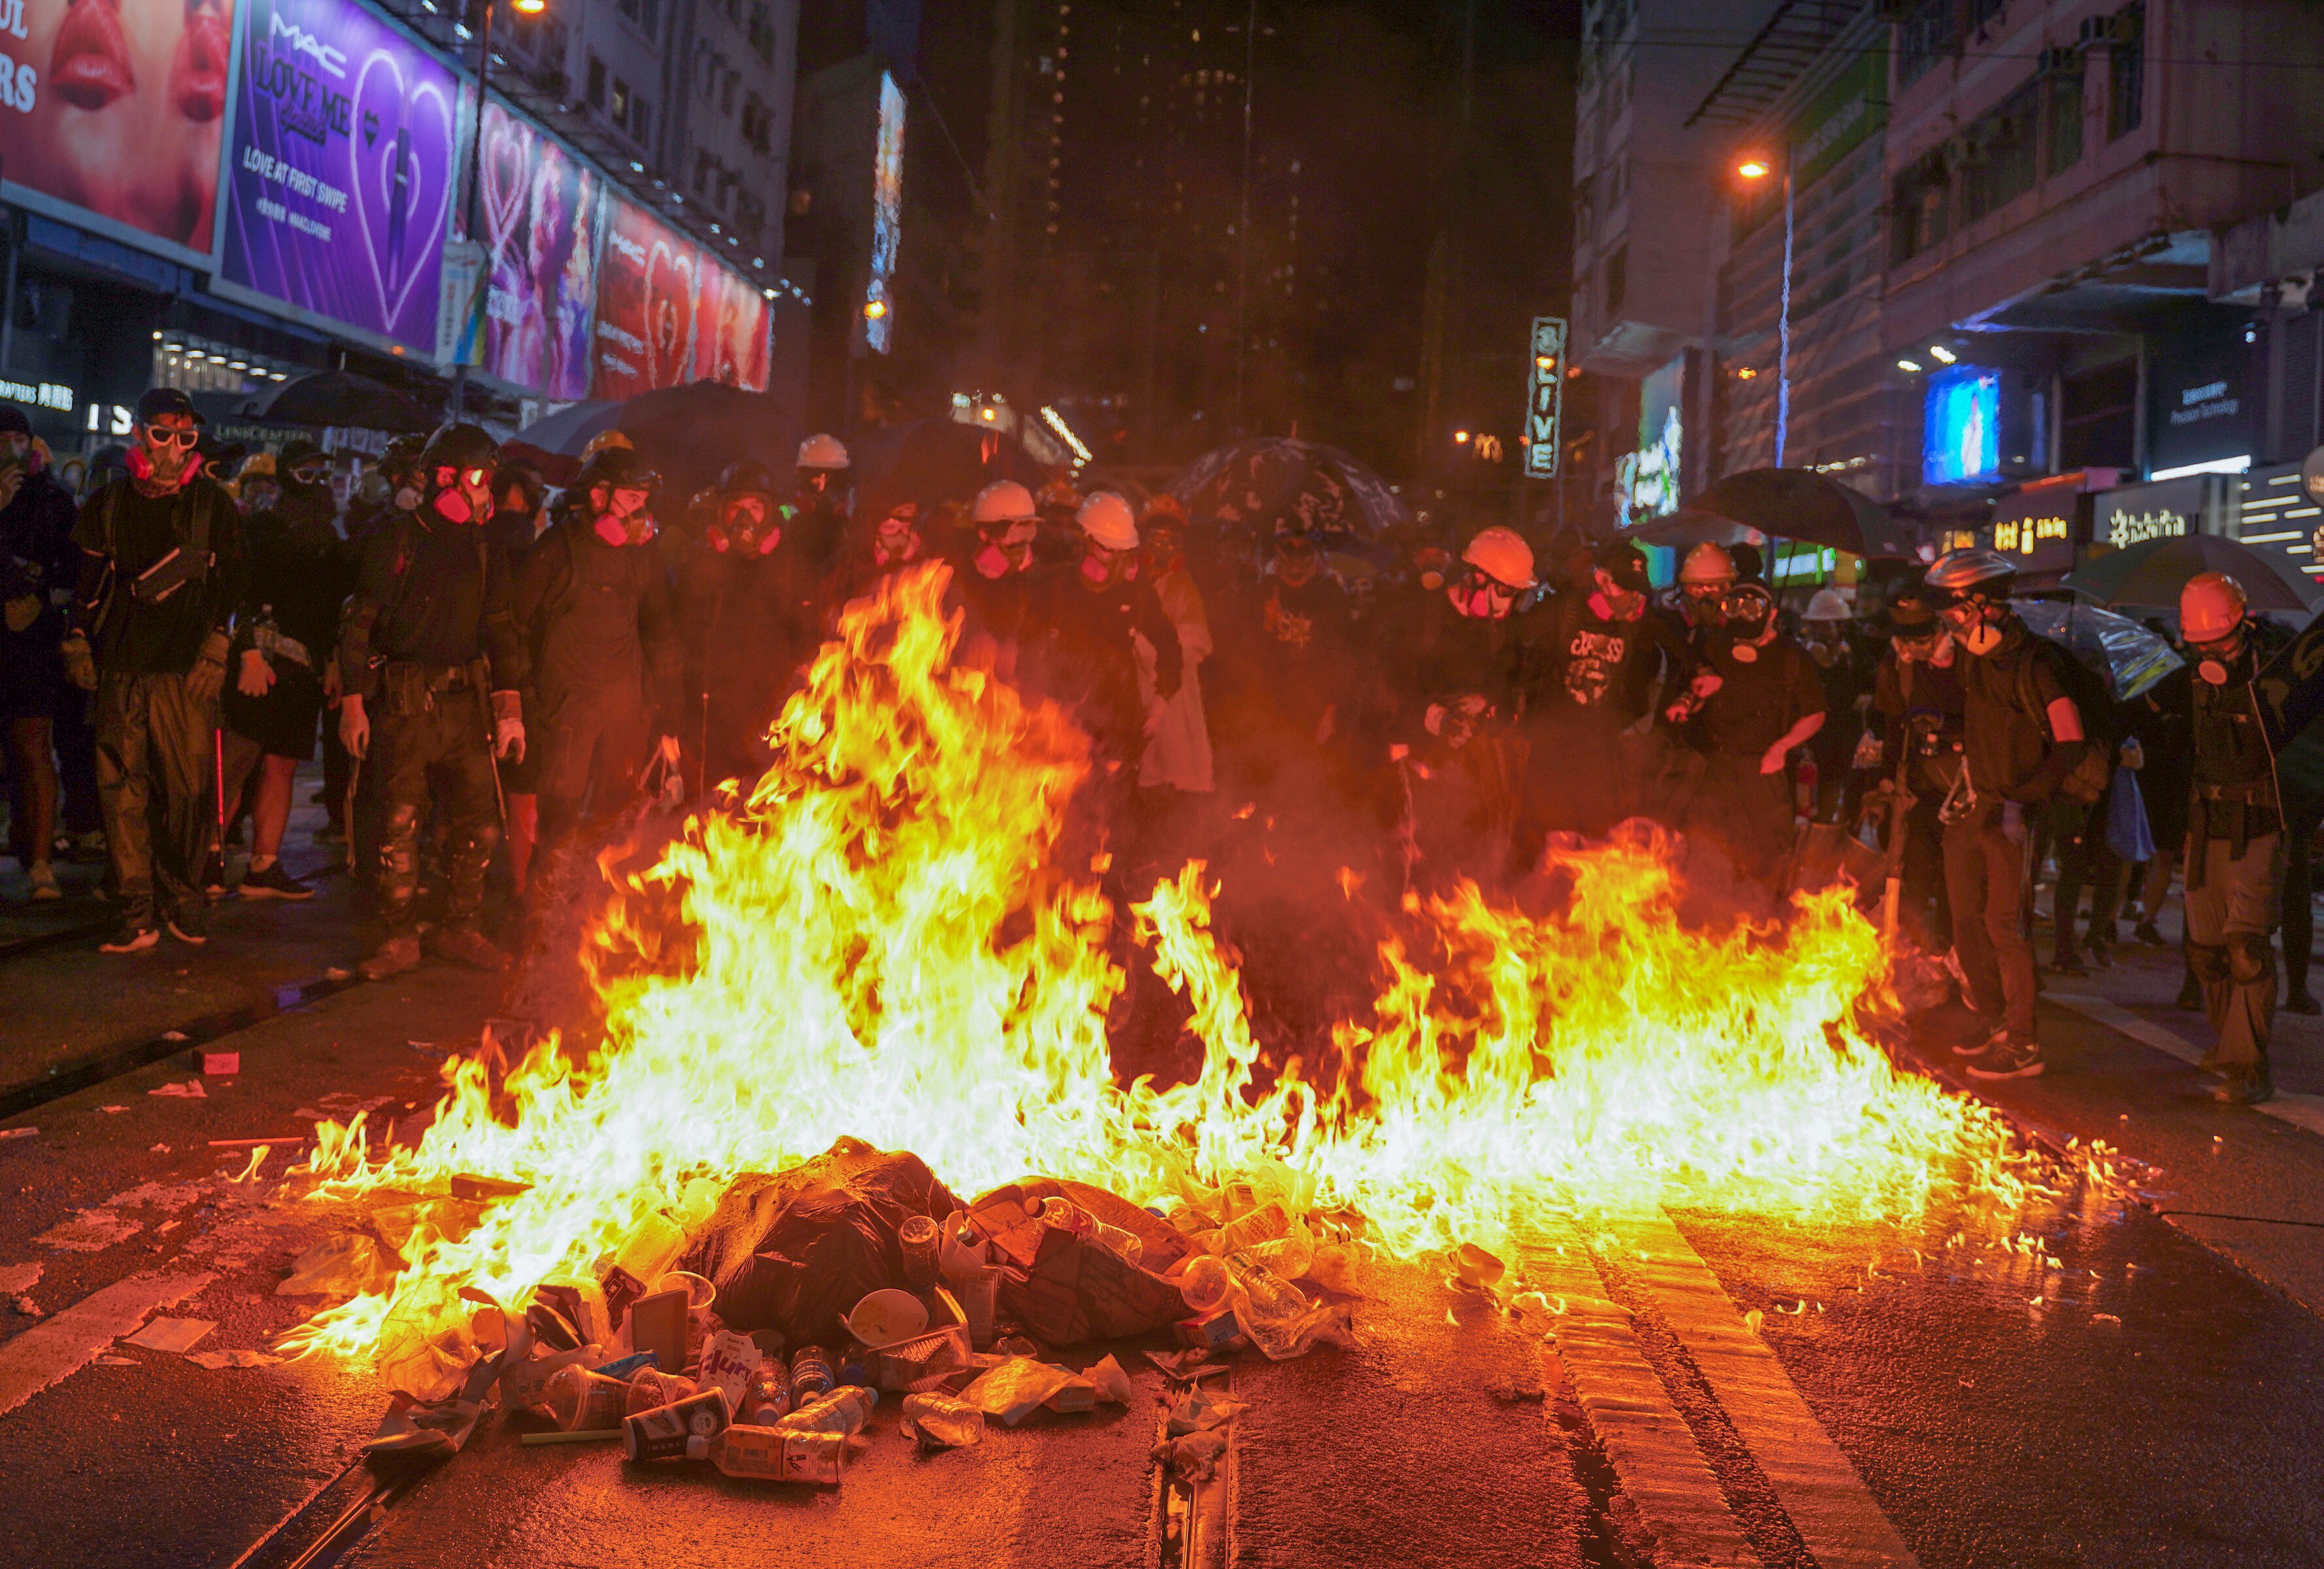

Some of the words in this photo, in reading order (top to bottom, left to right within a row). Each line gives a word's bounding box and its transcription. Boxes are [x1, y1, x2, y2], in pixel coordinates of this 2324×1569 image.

[256, 42, 317, 111] LOVE
[322, 86, 352, 138] ME
[243, 144, 275, 180] LOVE
[273, 161, 290, 186] AT
[286, 167, 318, 199] FIRST
[316, 181, 348, 214] SWIPE
